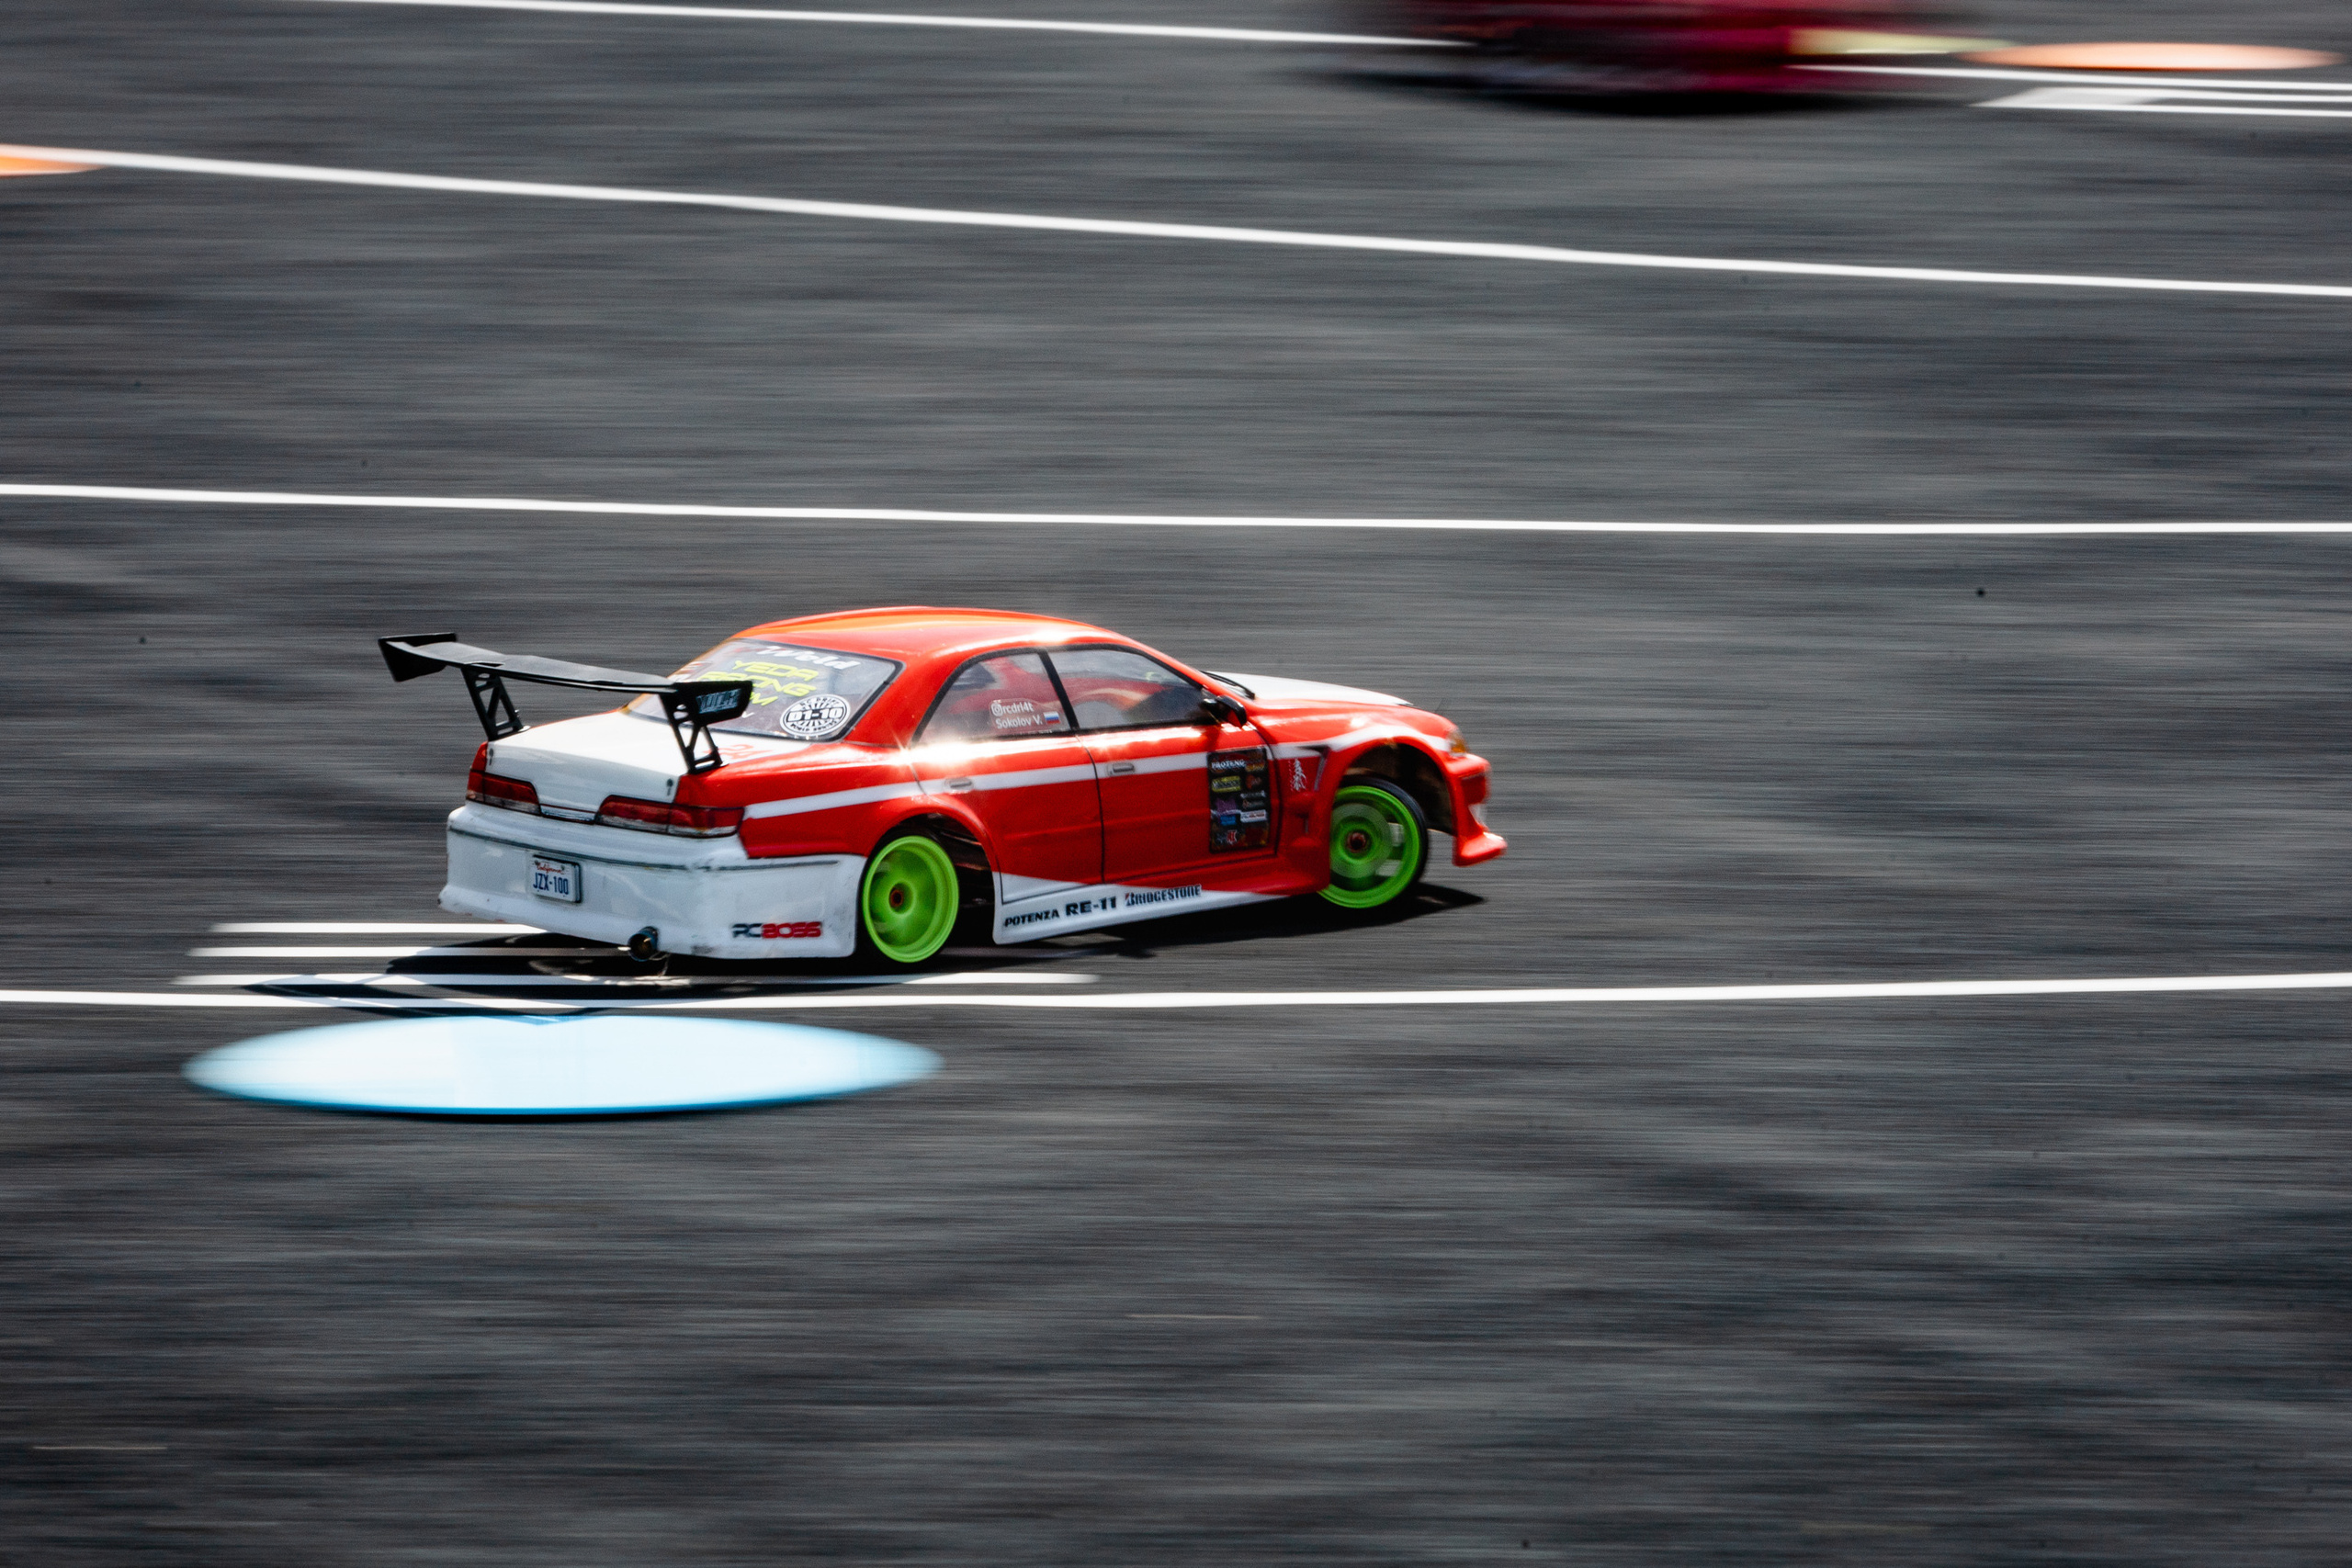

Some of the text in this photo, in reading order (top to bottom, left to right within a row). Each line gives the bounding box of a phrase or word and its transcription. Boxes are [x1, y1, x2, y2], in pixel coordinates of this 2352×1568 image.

[787, 707, 843, 722] D1-10
[996, 715, 1043, 728] Sokolov V.
[533, 872, 569, 895] JZX-100
[1003, 884, 1203, 928] POTENZA RE-11 BRIDGESTONE
[732, 921, 821, 939] RCBOSS
